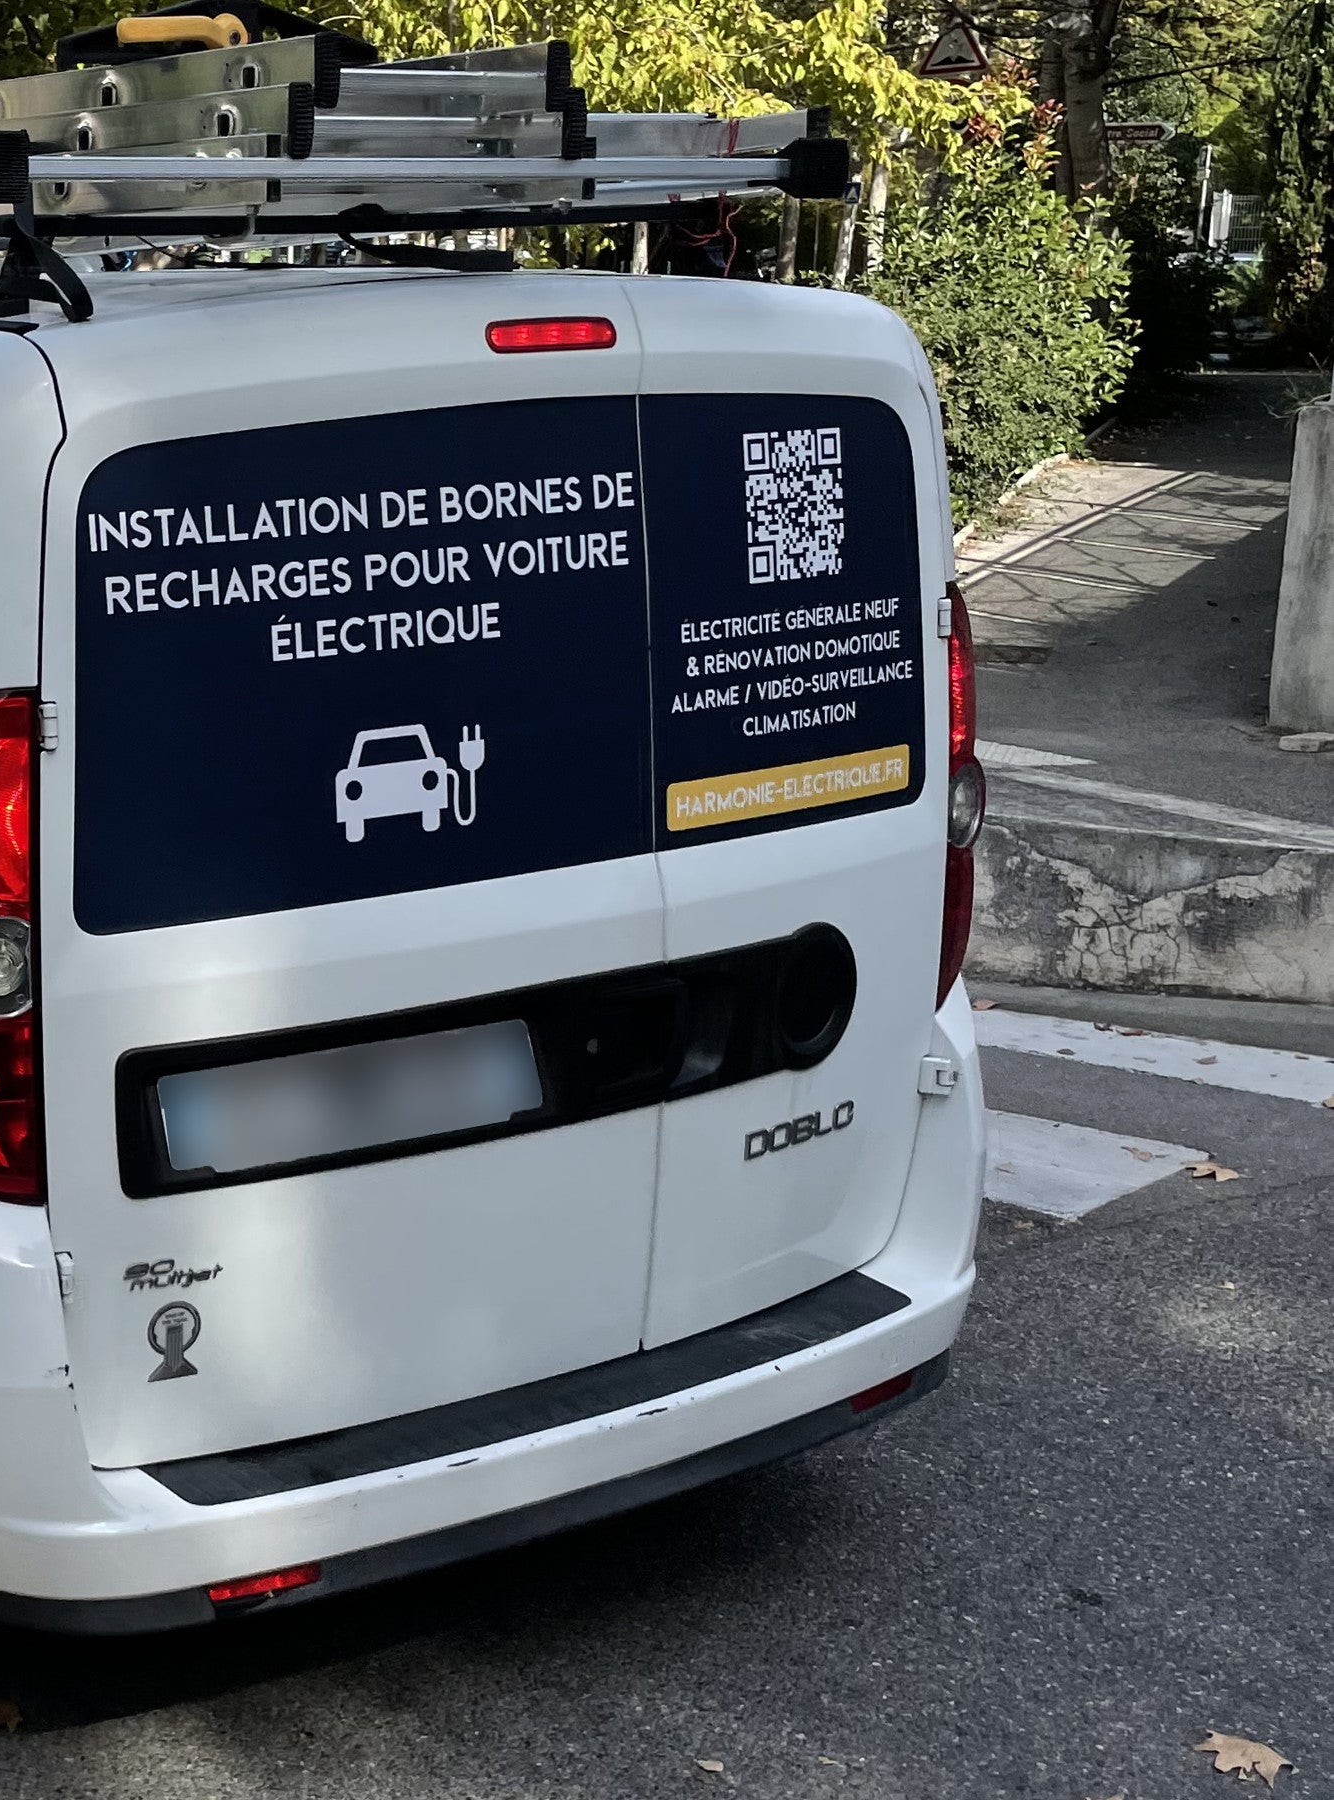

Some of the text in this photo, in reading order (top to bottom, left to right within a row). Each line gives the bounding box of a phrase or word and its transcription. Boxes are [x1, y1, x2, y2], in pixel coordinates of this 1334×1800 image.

[1126, 127, 1159, 138] Social
[88, 472, 635, 552] INSTALLATION DE BORNES DE
[105, 531, 628, 614] RECHARGES POUR VOITURE
[271, 603, 501, 662] ÉLECTRIQUE
[681, 598, 899, 643] ÉLECTRICITÉ GÉNÉRALE NEUF
[686, 630, 900, 677] & RÉNOVATION DOMOTIQUE
[671, 660, 913, 714] ALARME / VIDÉO-SURVEILLANCE
[743, 702, 856, 736] CLIMATISATION
[676, 758, 903, 818] HARMONIE-ELECTRIQUE.FR
[744, 1100, 854, 1161] DOBLO
